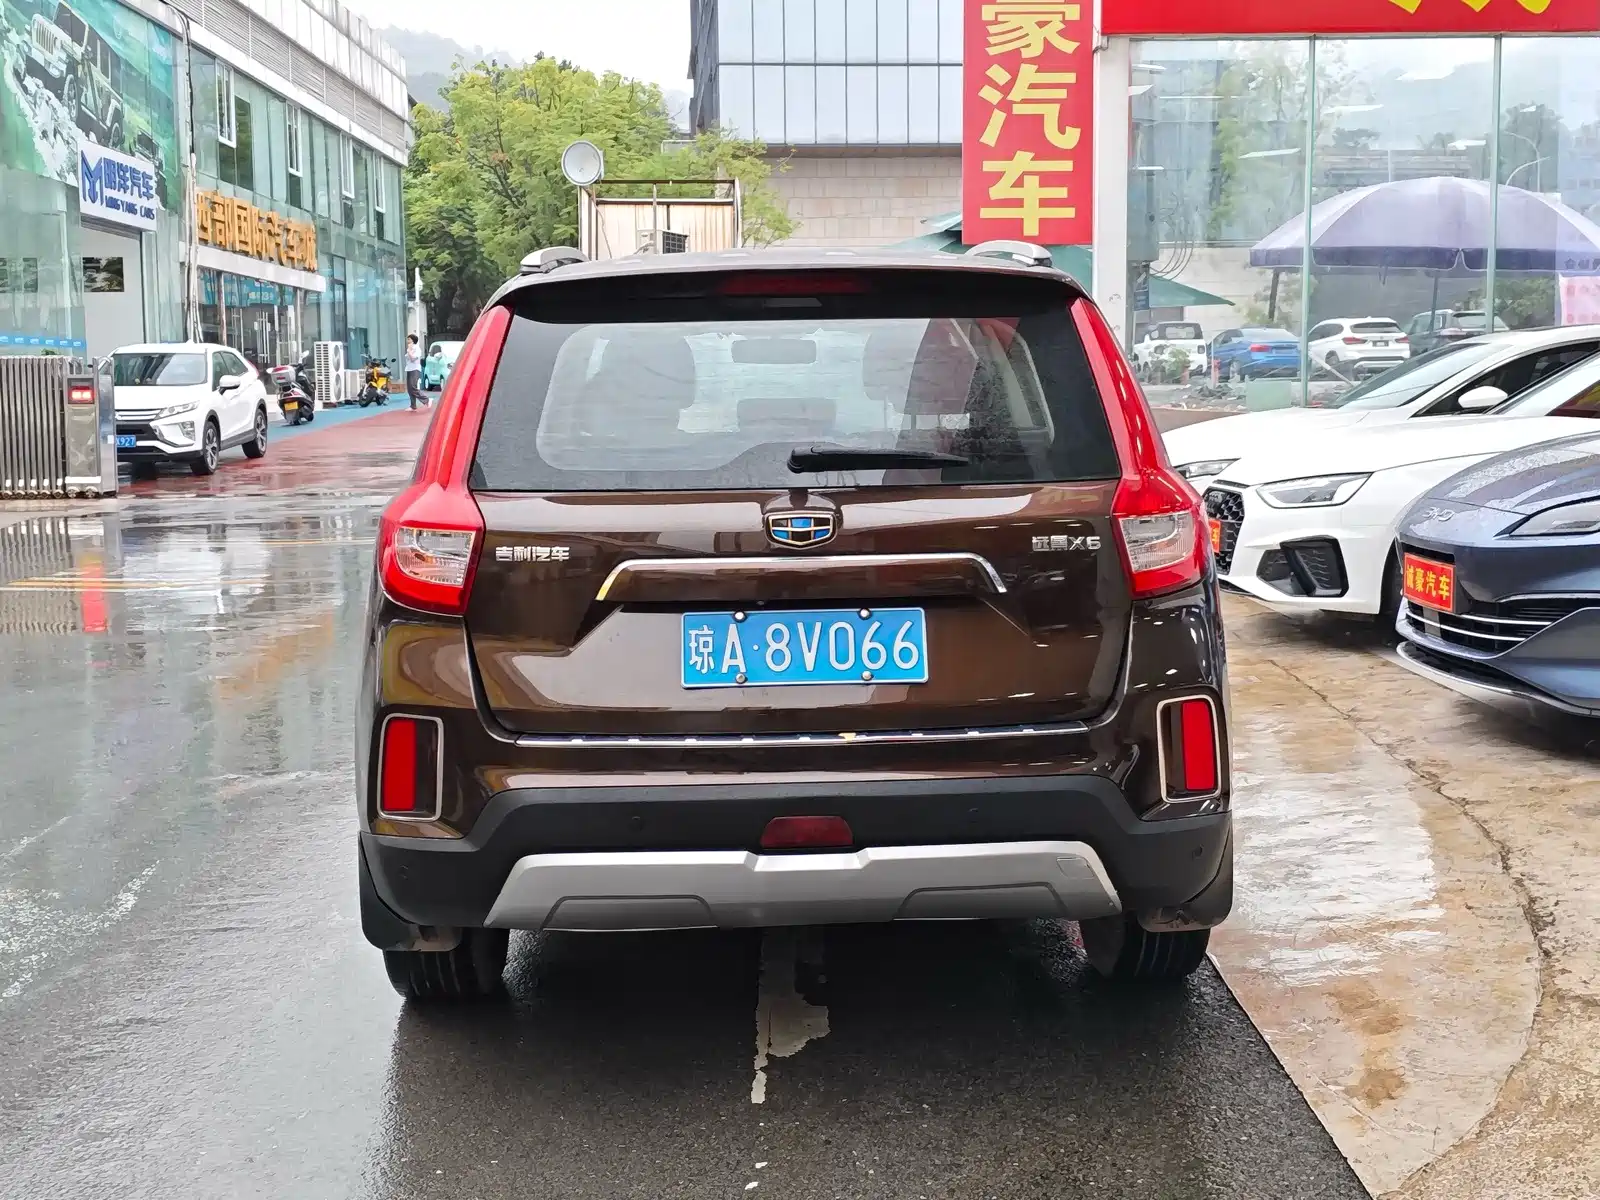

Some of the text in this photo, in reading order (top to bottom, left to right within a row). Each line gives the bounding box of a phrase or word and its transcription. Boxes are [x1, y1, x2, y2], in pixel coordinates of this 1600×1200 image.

[1032, 535, 1101, 552] 远景X6
[495, 546, 570, 562] 吉利汽车
